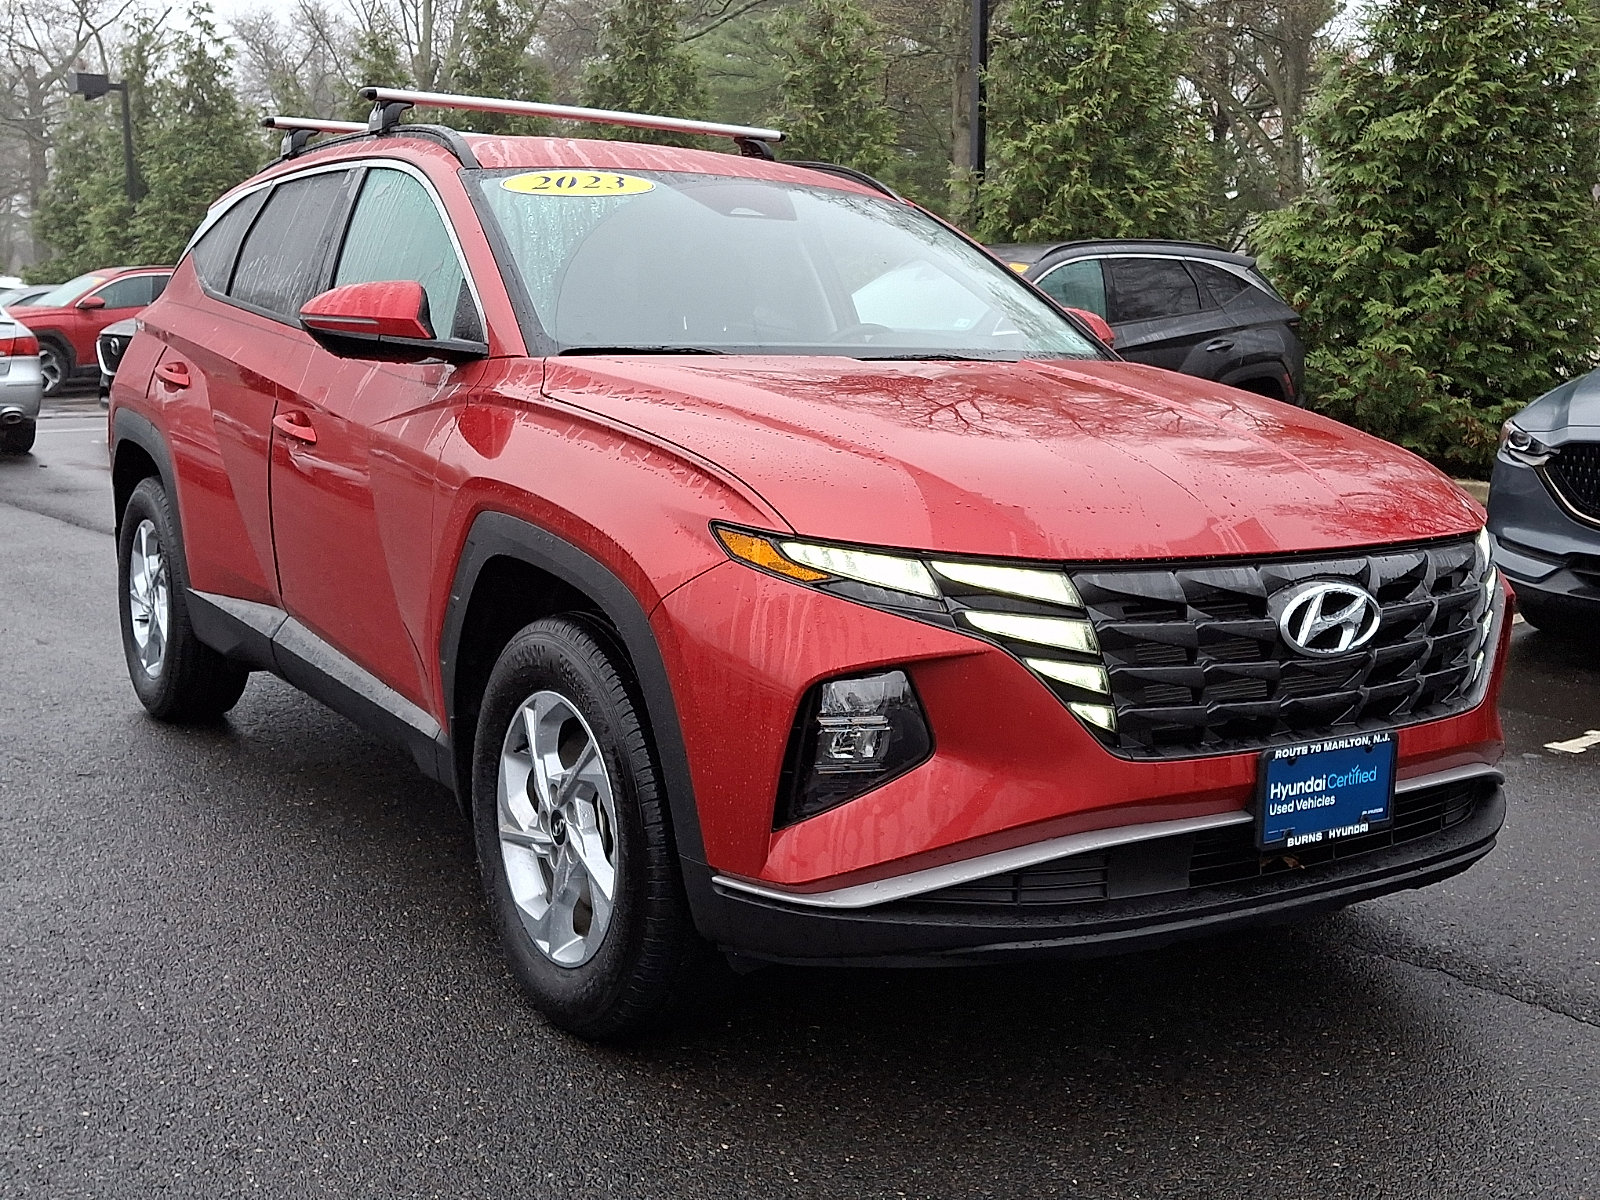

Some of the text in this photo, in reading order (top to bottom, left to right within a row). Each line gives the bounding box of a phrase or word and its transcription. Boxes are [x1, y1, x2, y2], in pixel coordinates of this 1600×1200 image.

[532, 175, 625, 190] 2023
[1275, 733, 1390, 759] ROUTE 70 MARLTON, N.J.
[1270, 766, 1377, 801] Hyundai Certified
[1269, 794, 1335, 815] Used Vehicles
[1287, 823, 1369, 847] BURNS HYUNDAI
